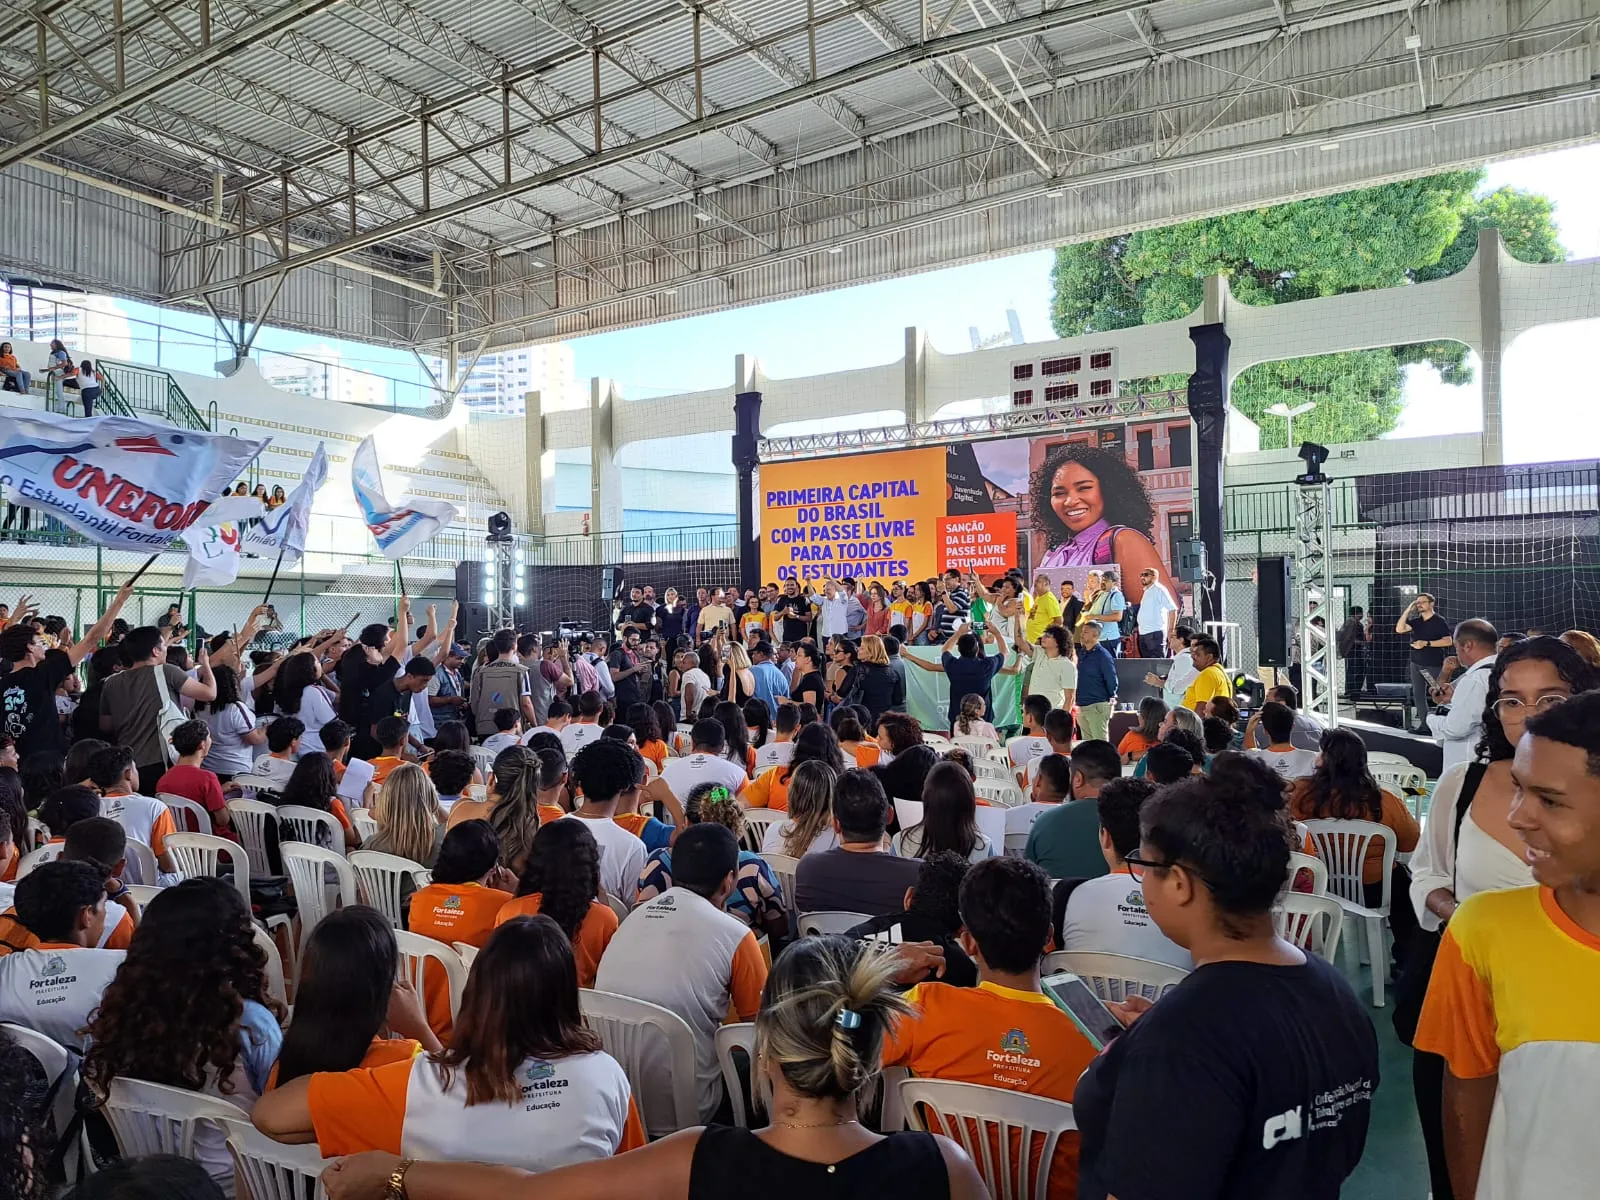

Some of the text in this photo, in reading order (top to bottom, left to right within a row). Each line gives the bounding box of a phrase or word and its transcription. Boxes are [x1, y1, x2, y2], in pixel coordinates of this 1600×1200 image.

[766, 479, 919, 507] PRIMEIRA CAPITAL
[954, 485, 983, 497] Juventude
[18, 478, 119, 533] Estudantil
[797, 502, 885, 524] DO BRASIL
[771, 519, 915, 544] COM PASSE LIVRE
[946, 520, 985, 533] SANÇÃO
[244, 531, 277, 547] União
[946, 533, 991, 545] DA LEI DO
[790, 541, 893, 562] PARA TODOS
[946, 544, 1007, 557] PASSE LIVRE
[777, 560, 909, 581] OS ESTUDANTES
[946, 557, 1006, 569] ESTUDANTIL
[432, 906, 465, 916] Fortaleza
[30, 975, 77, 990] Fortaleza
[986, 1049, 1041, 1068] Fortaleza
[992, 1063, 1032, 1074] PREFEITURA
[520, 1079, 569, 1094] ortaleza
[993, 1073, 1028, 1087] Educação
[526, 1100, 561, 1112] Educação
